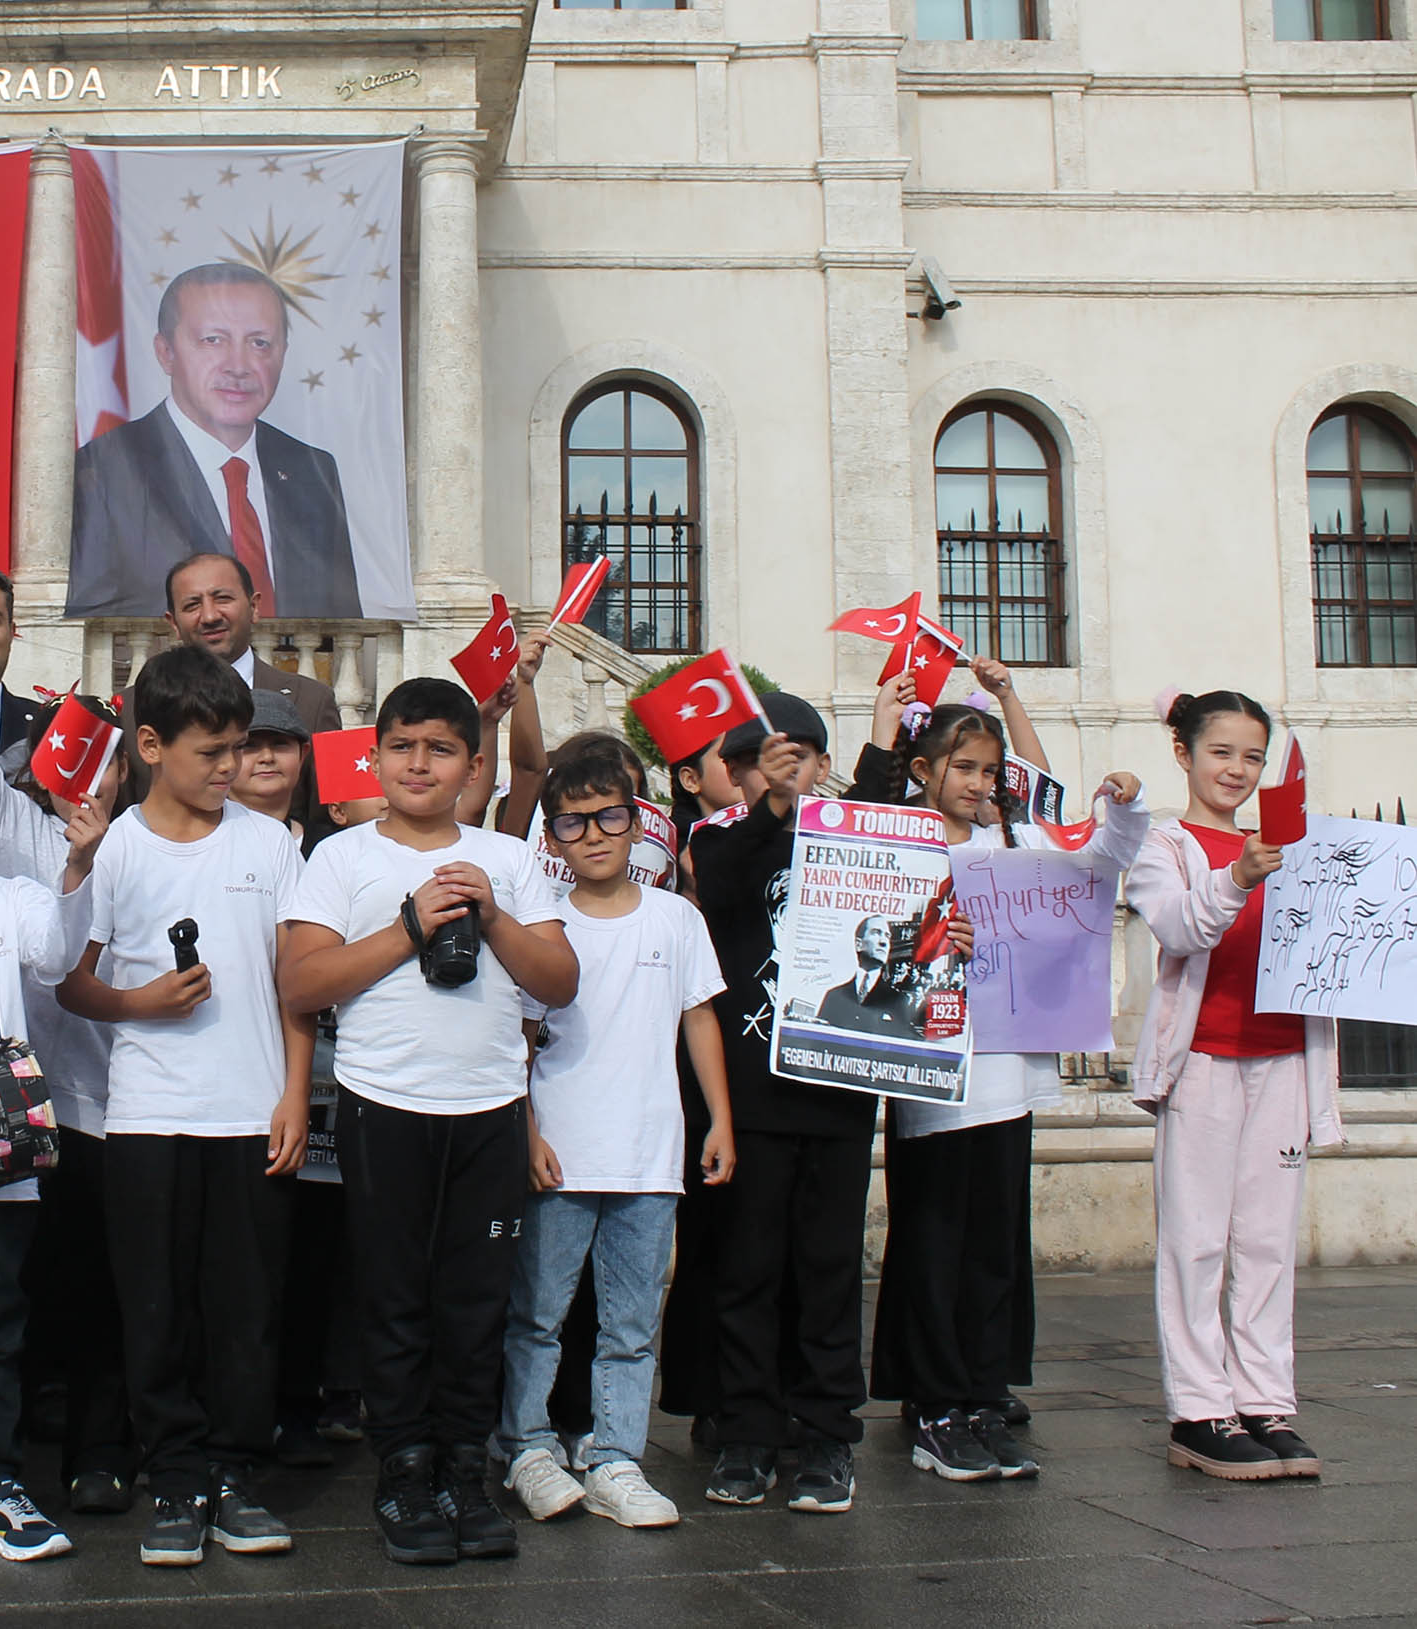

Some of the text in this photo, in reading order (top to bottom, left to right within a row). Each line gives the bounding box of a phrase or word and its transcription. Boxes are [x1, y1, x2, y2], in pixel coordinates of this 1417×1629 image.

[154, 64, 283, 99] ATTIK
[853, 809, 947, 842] TOMURCU
[805, 845, 901, 872] EFENDİLER,
[803, 867, 842, 887] YARIN
[800, 884, 906, 916] İLAN EDECEĞİZ!
[932, 1003, 960, 1020] 1923
[832, 1054, 870, 1077] KAYITSIZ
[870, 1059, 906, 1082] ŞARTSIZ
